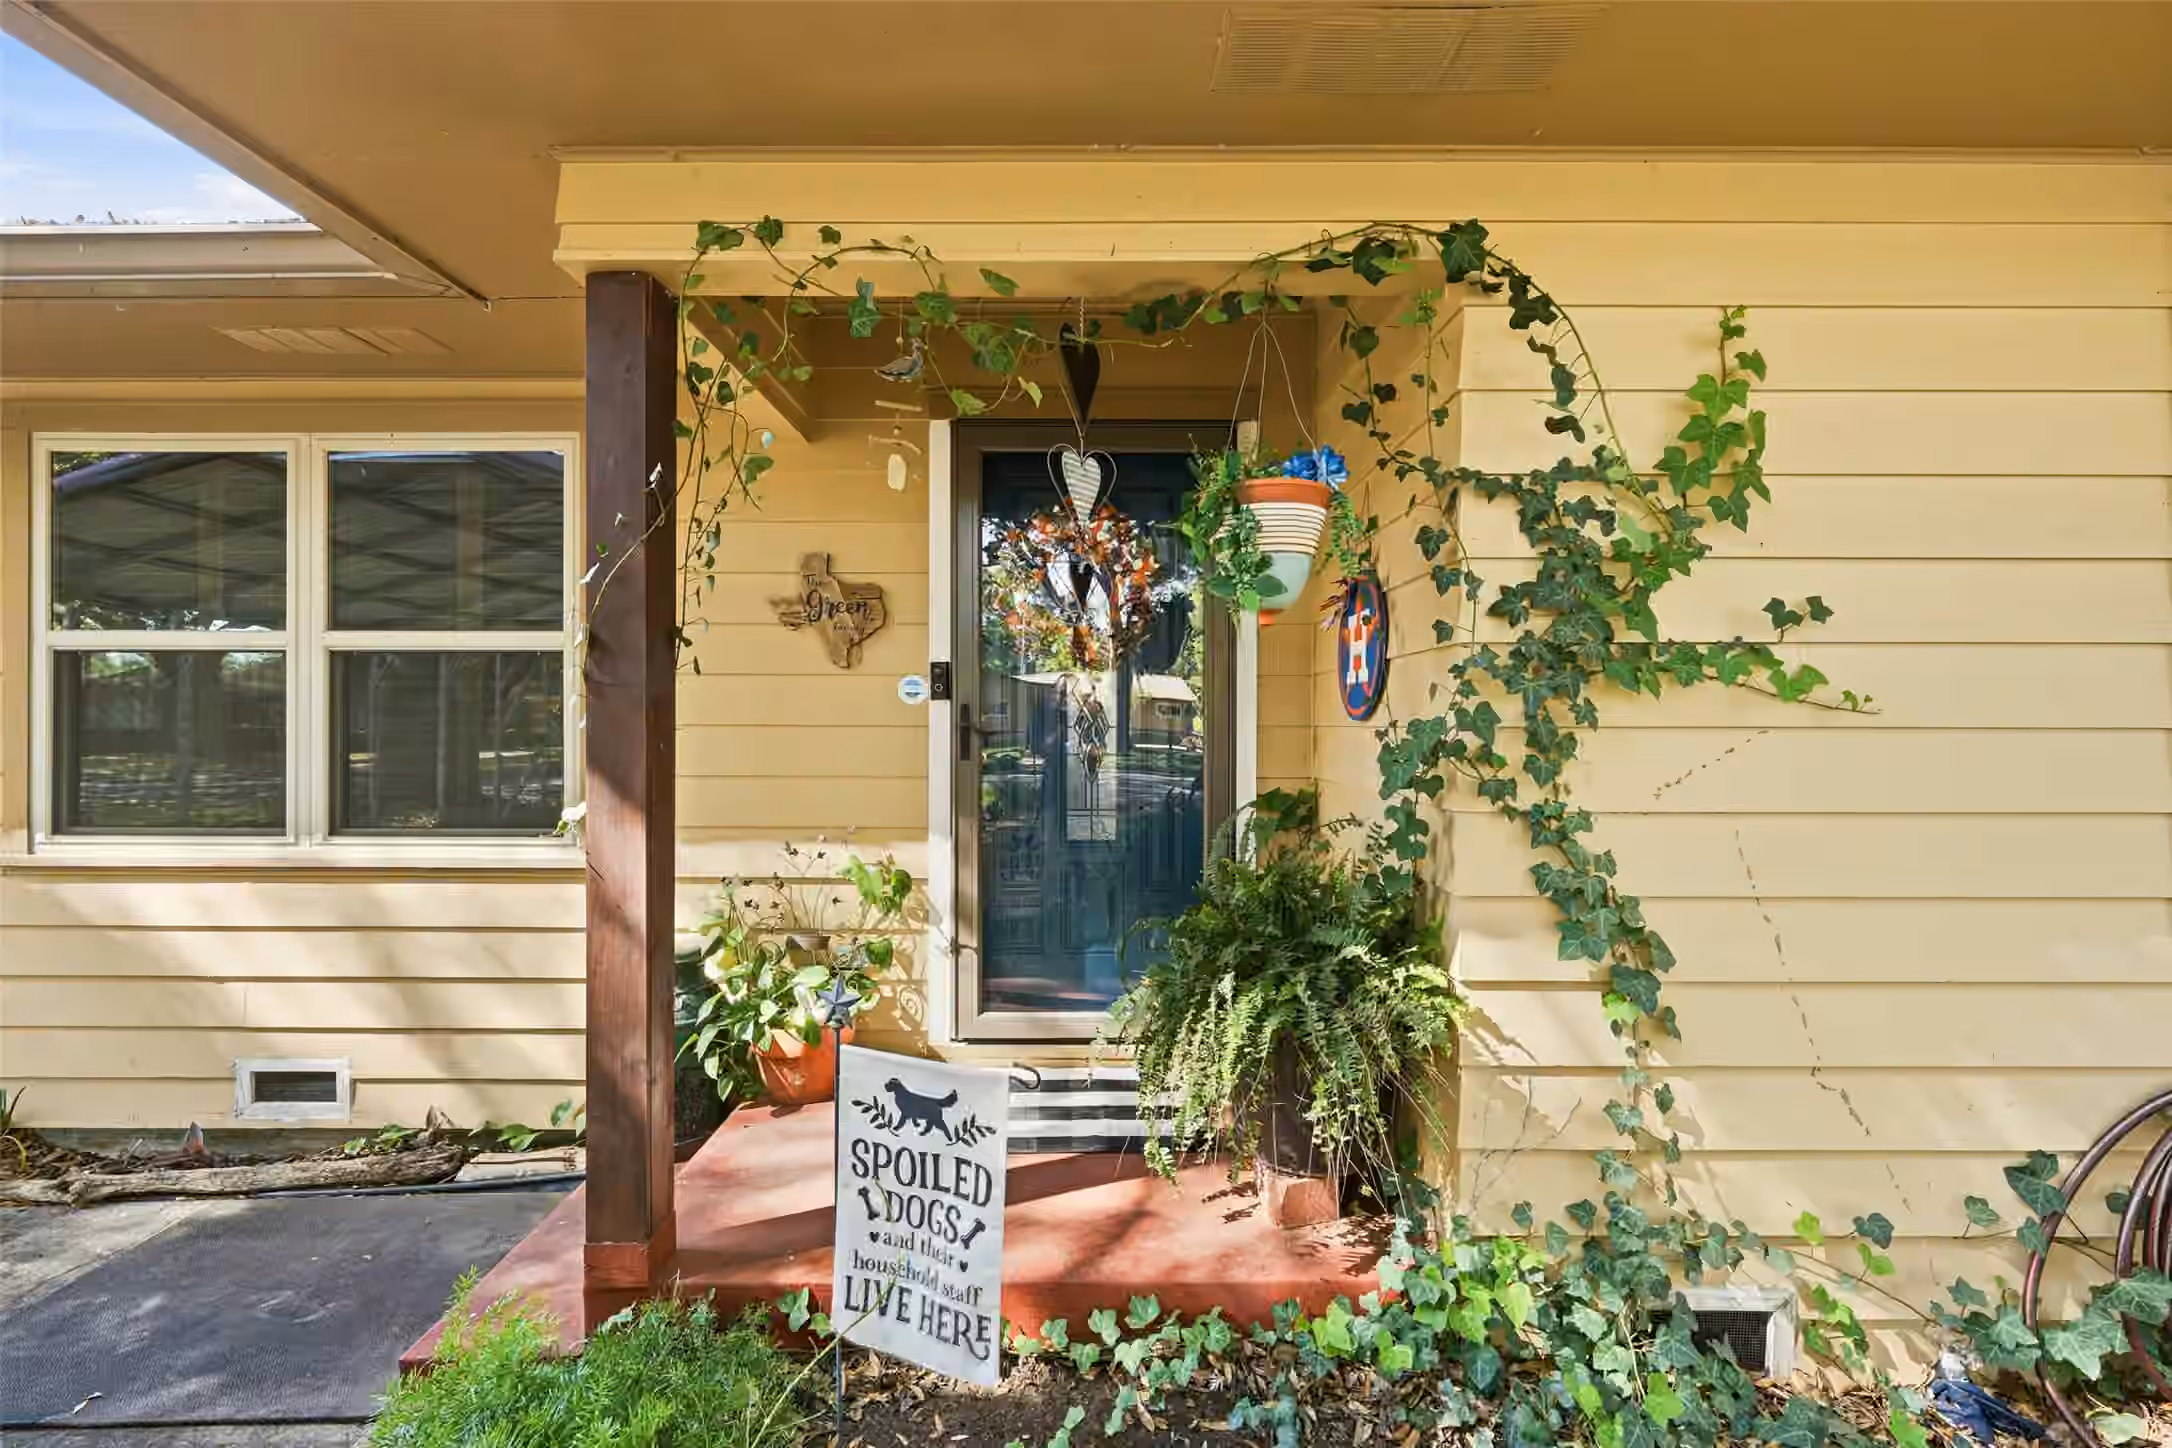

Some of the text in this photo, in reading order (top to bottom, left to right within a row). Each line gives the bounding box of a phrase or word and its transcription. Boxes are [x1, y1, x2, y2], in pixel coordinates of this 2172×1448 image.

[851, 1137, 993, 1208] SPOILED
[885, 1189, 962, 1244] DOGS
[853, 1249, 983, 1306] household staff
[882, 1231, 955, 1269] and their
[844, 1275, 992, 1361] LIVE HERE
